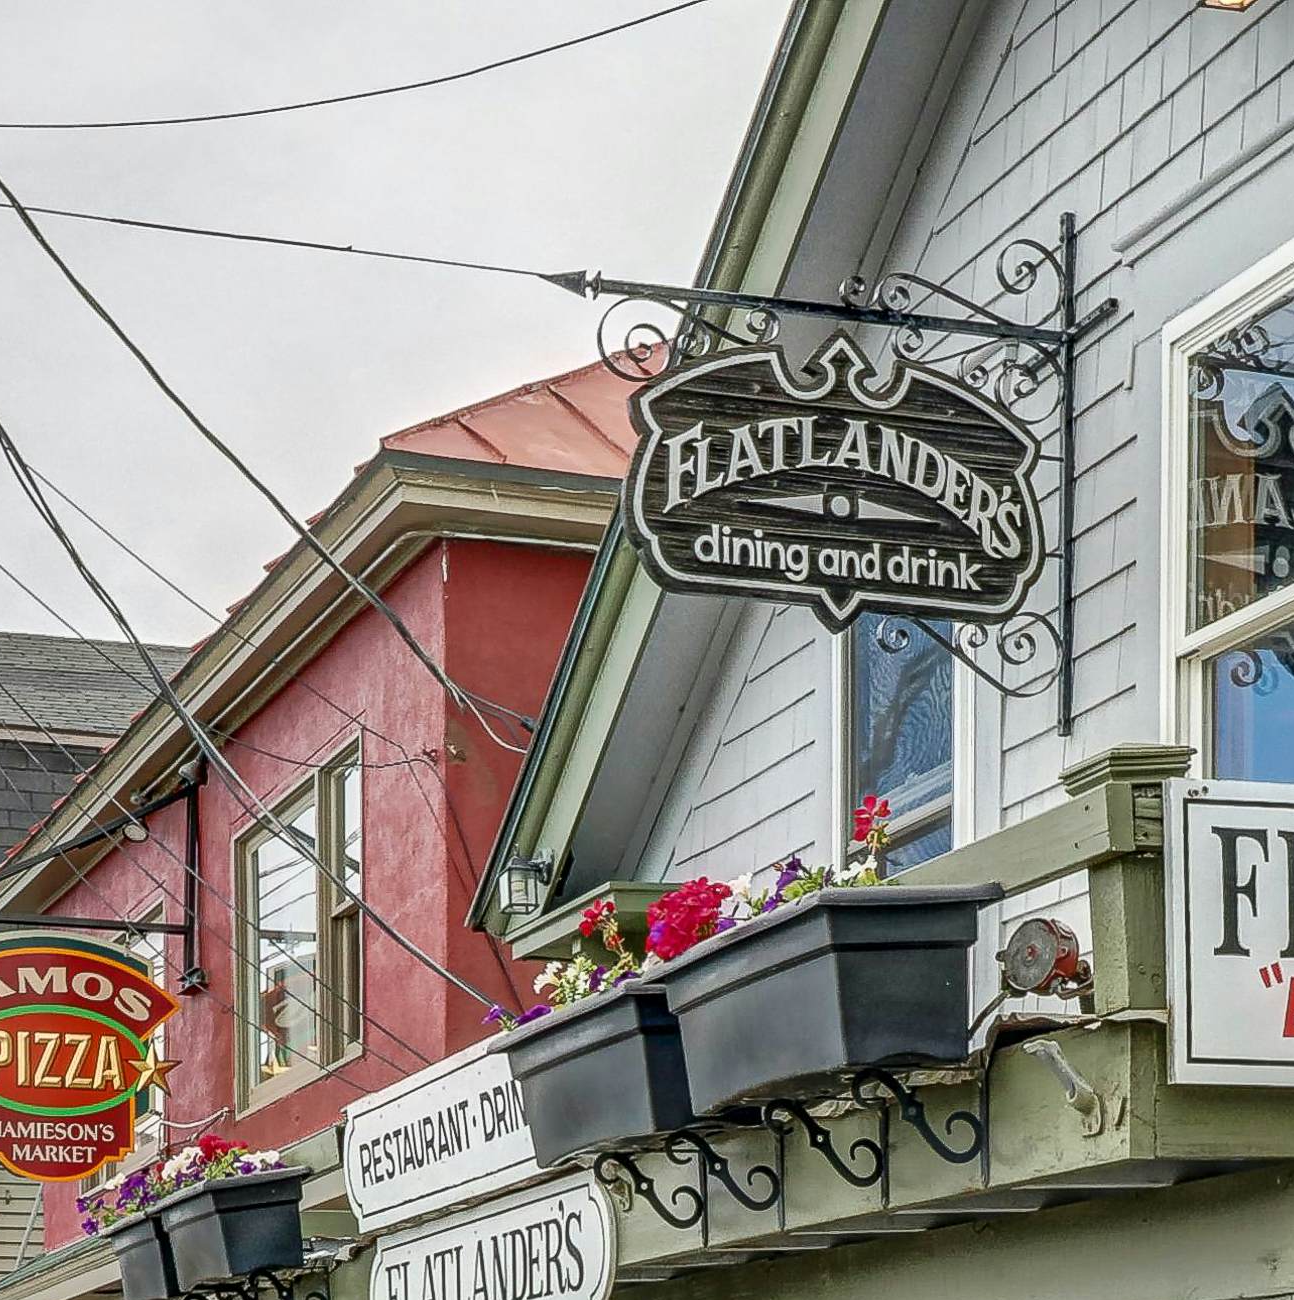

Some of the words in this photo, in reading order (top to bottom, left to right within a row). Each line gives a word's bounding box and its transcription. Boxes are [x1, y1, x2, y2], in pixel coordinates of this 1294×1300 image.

[662, 415, 1022, 559] FLATLANDER'S
[694, 523, 809, 582] dining
[818, 543, 881, 581] and
[887, 546, 983, 591] drink
[12, 1143, 96, 1164] MARKET
[359, 1099, 471, 1188] RESTAURANT
